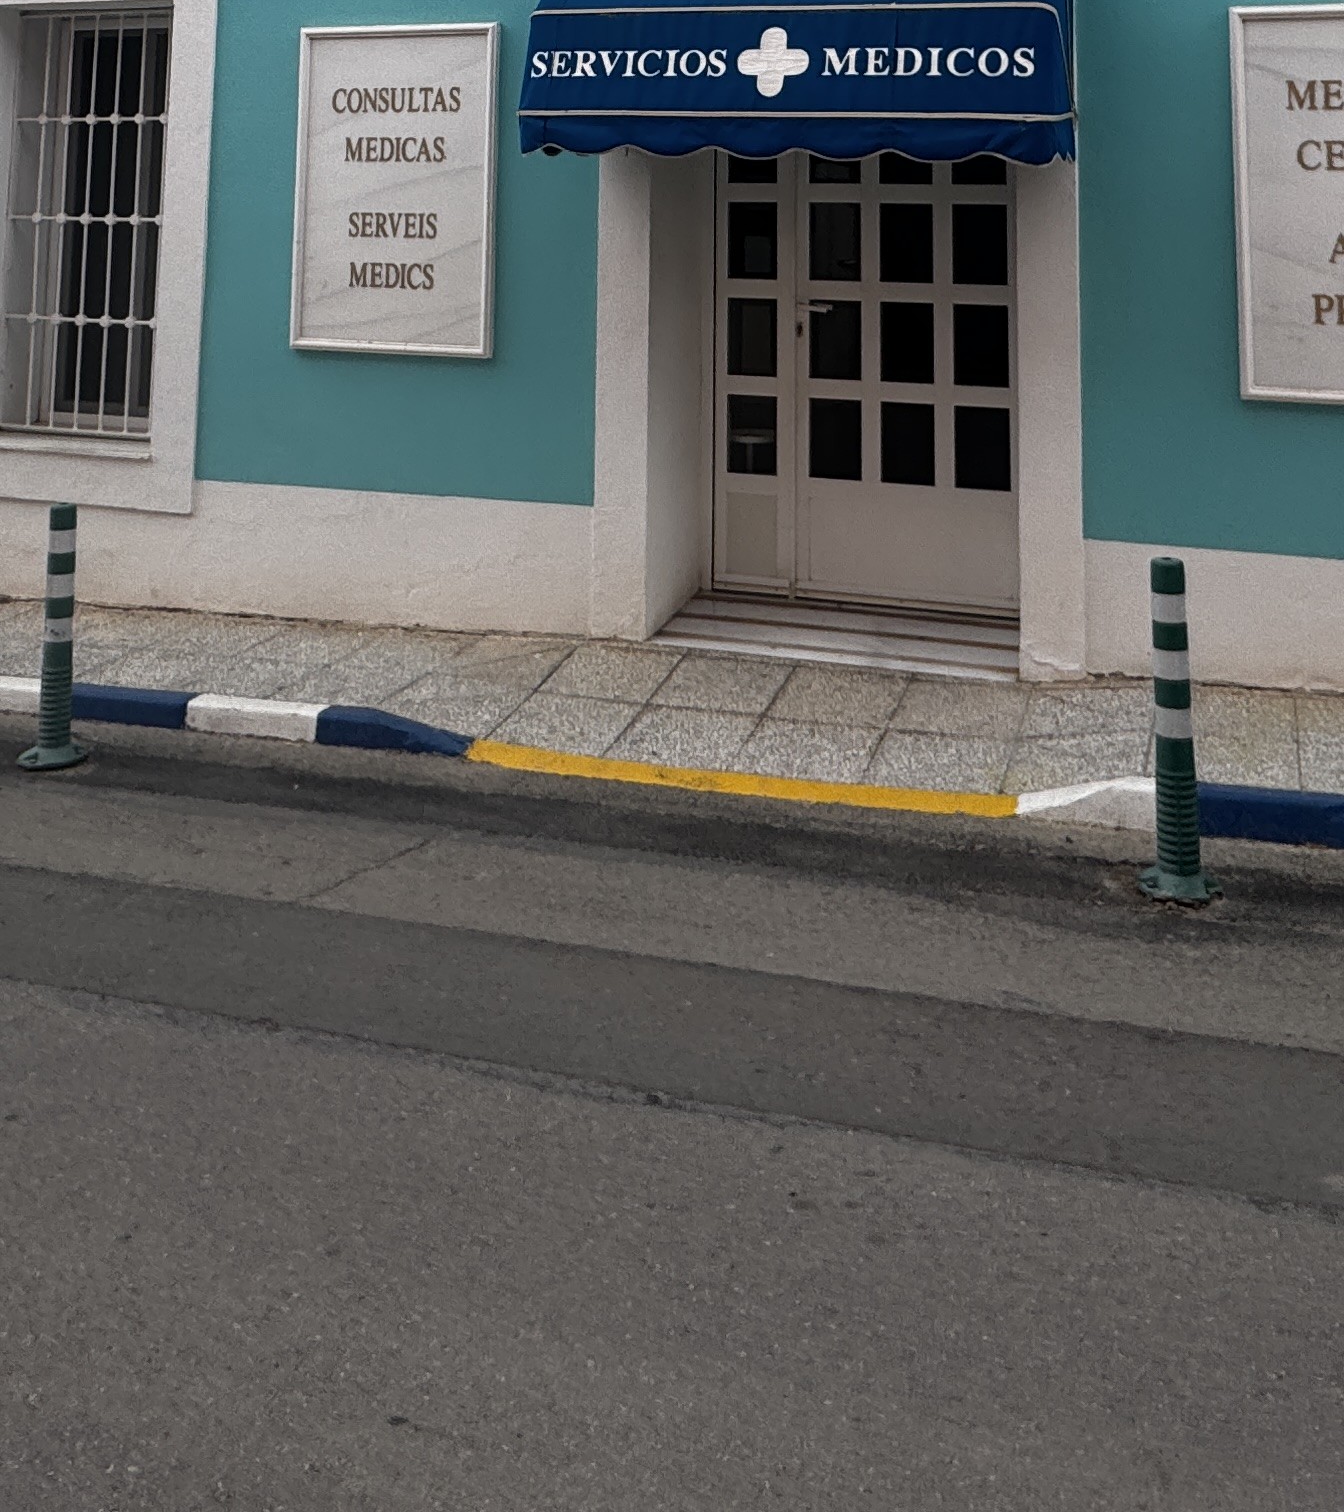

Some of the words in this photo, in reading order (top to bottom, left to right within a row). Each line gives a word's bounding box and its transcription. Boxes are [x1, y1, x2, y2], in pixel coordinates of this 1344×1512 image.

[529, 48, 728, 80] SERVICIOS
[820, 46, 1037, 79] MEDICOS
[332, 87, 461, 114] CONSULTAS
[344, 136, 447, 163] MEDICAS
[348, 212, 438, 239] SERVEIS
[348, 262, 435, 290] MEDICS
